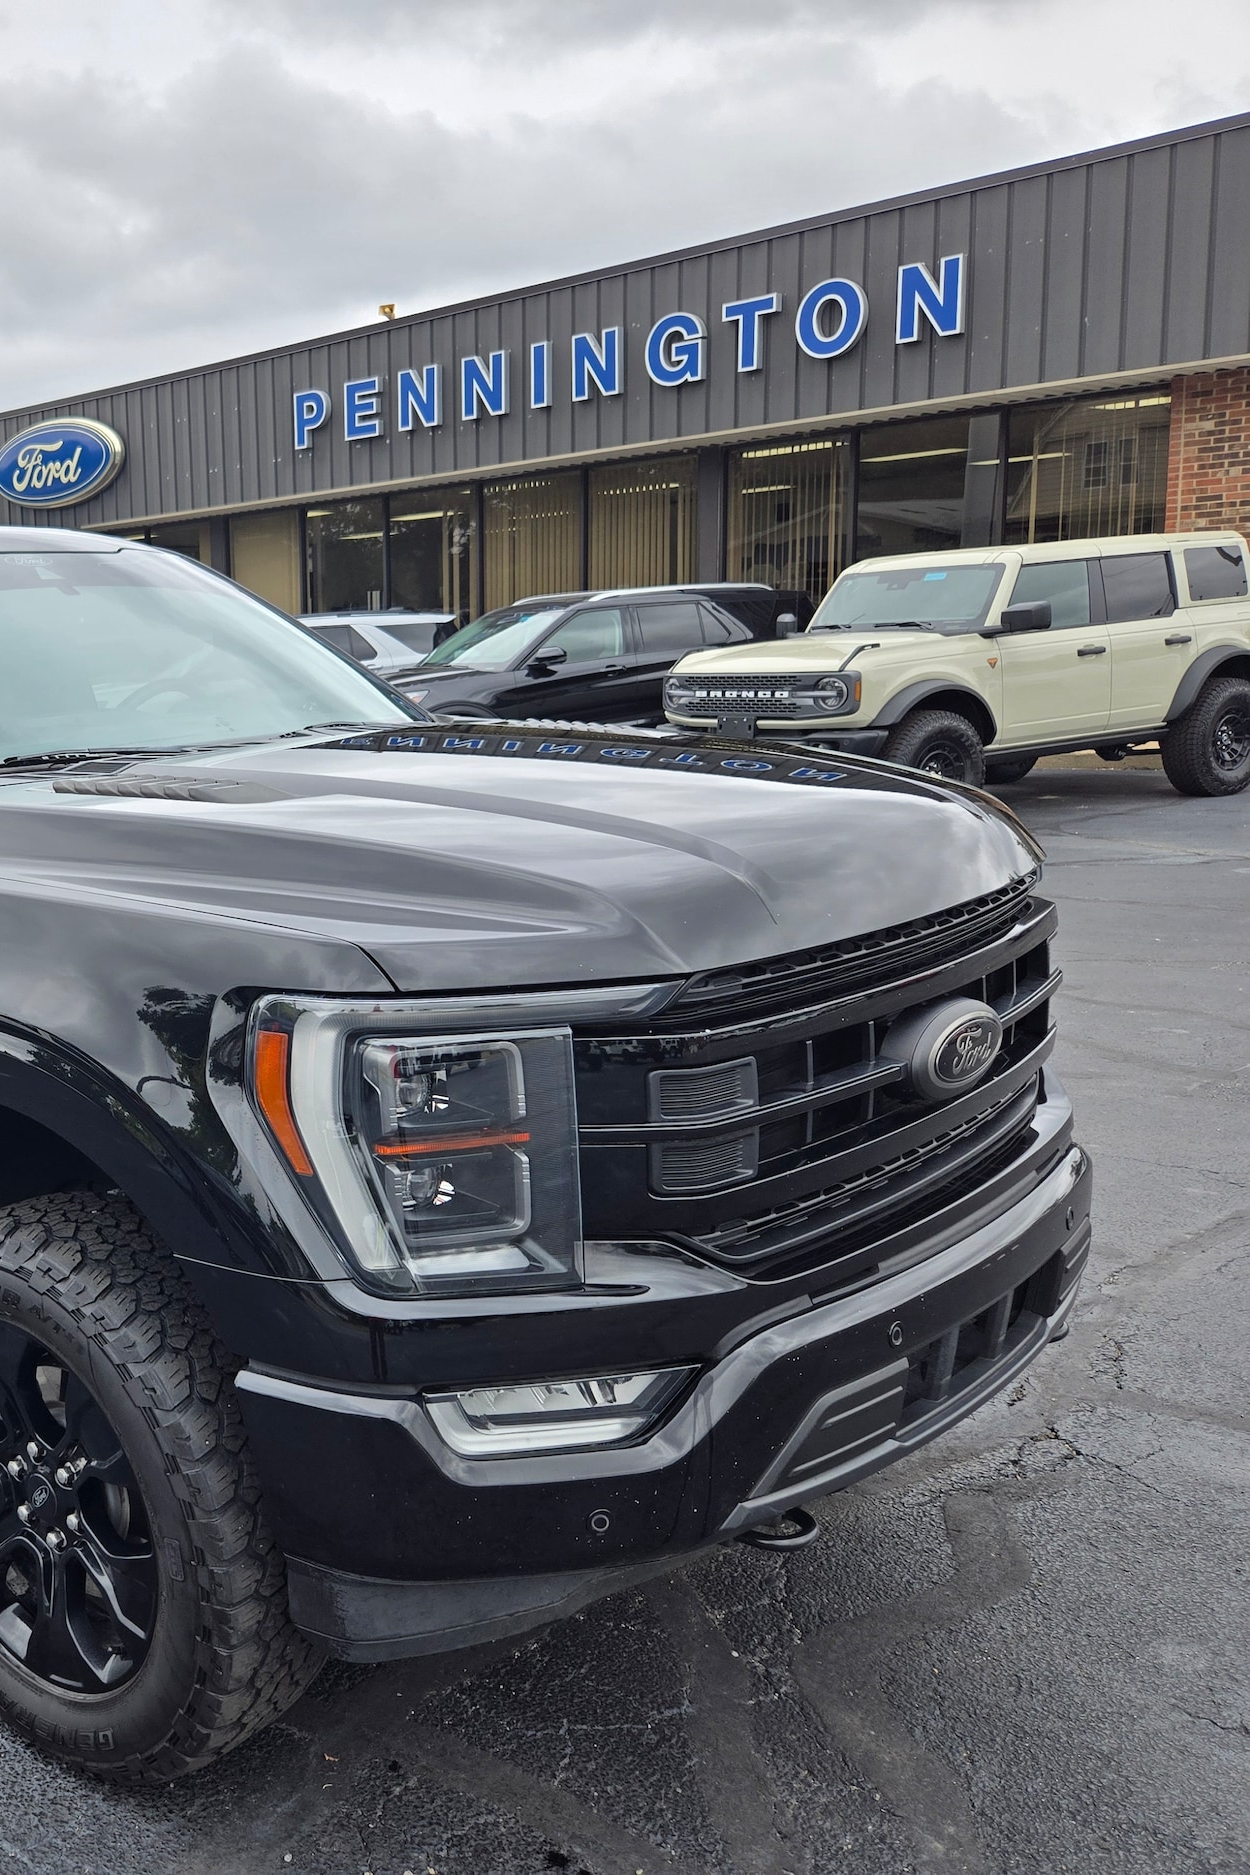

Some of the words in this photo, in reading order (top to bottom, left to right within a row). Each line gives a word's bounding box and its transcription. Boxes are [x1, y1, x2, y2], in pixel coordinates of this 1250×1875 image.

[293, 252, 967, 451] PENNINGTON
[12, 440, 82, 492] Ford
[695, 690, 789, 698] BRONCO
[953, 1028, 991, 1074] Ford
